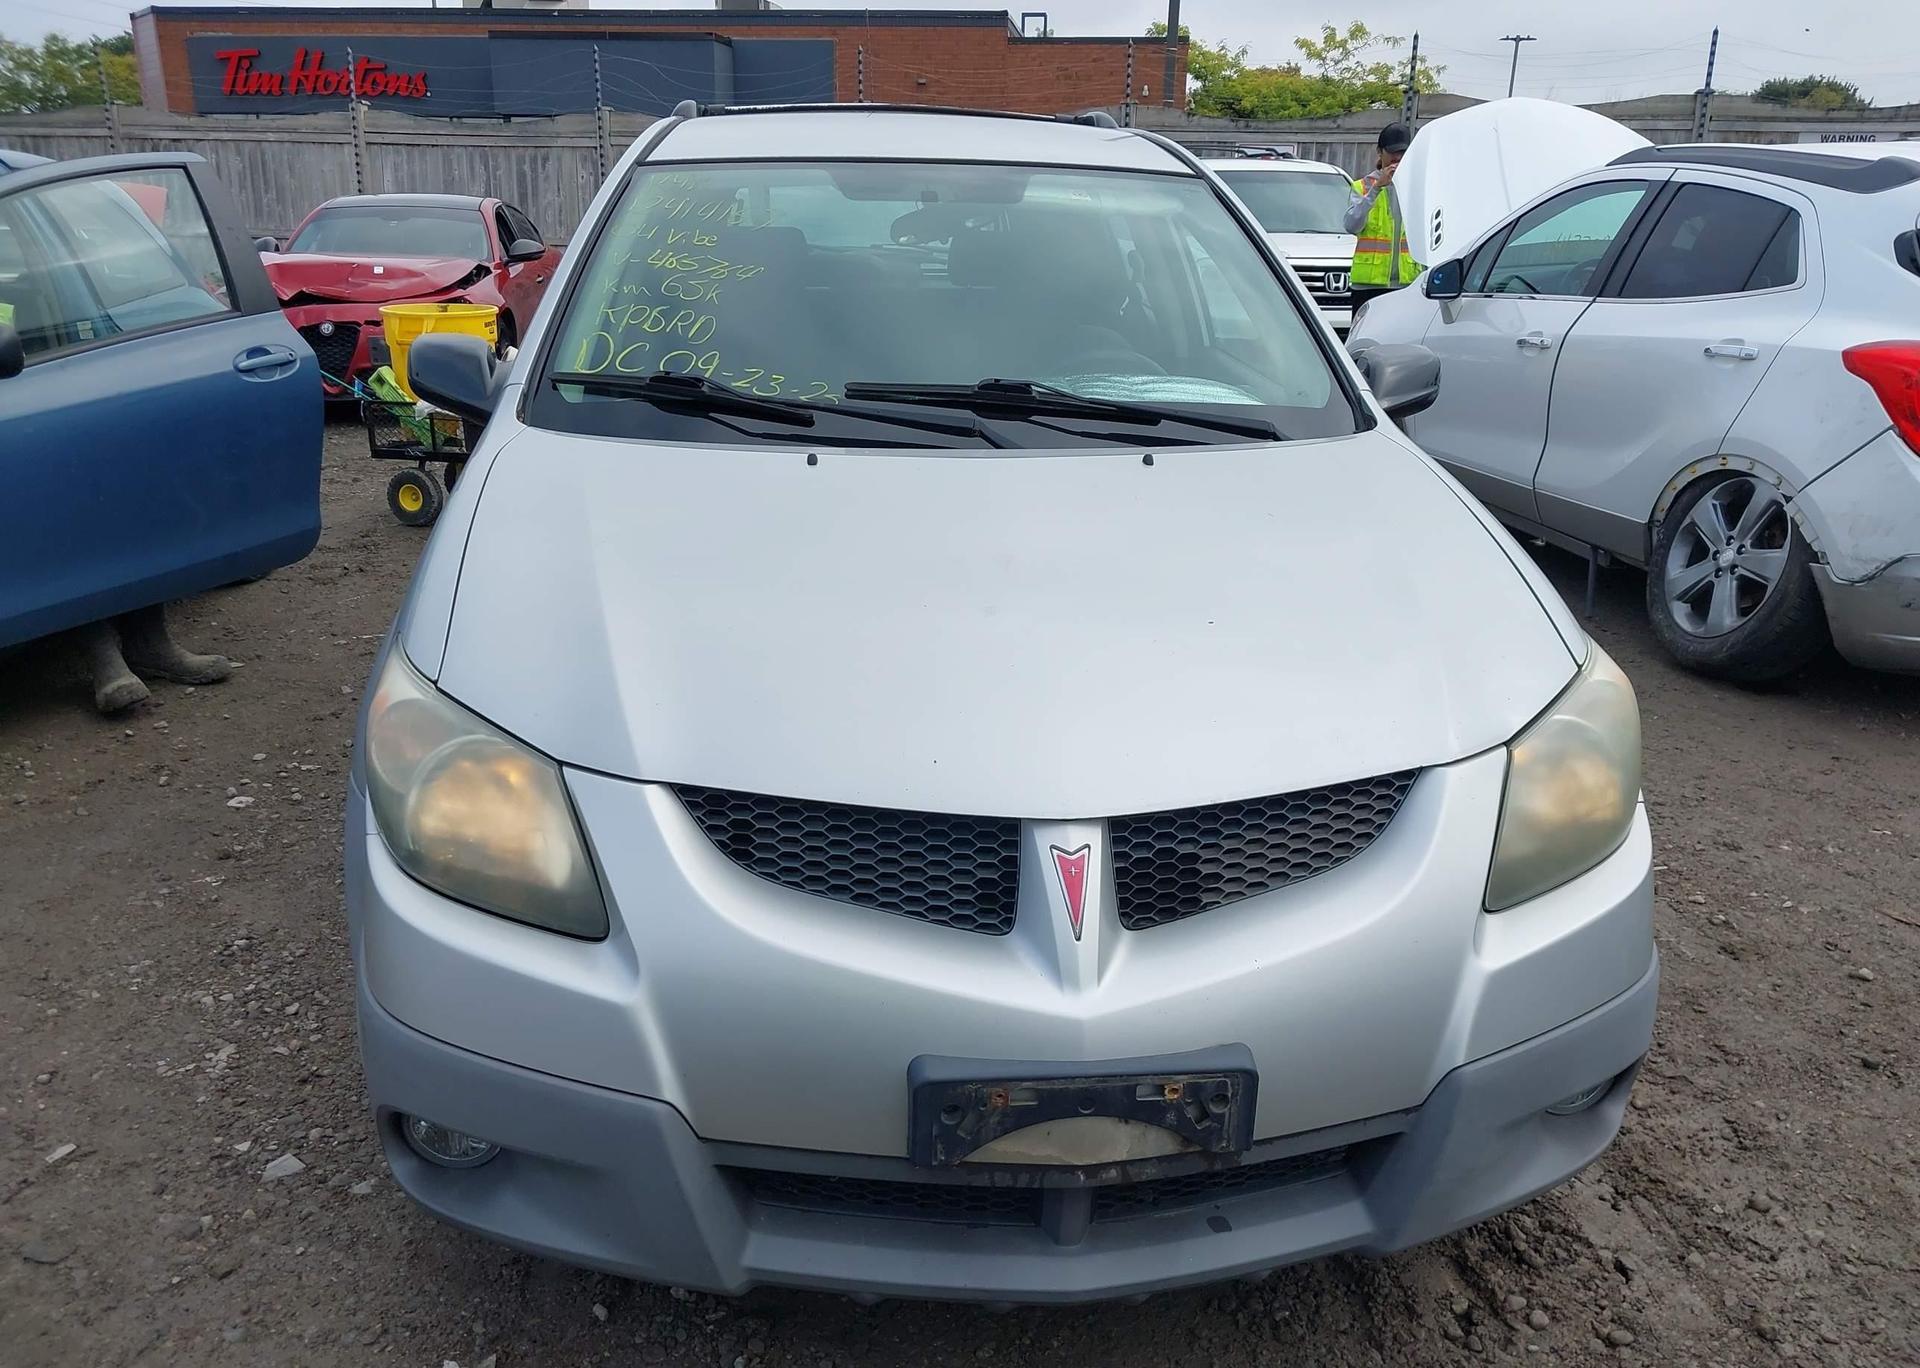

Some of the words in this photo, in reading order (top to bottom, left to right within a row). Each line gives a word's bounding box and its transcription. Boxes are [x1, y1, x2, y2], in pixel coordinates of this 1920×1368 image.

[214, 49, 284, 96] Tim
[288, 47, 429, 97] Hortons
[1820, 134, 1877, 142] WARNING
